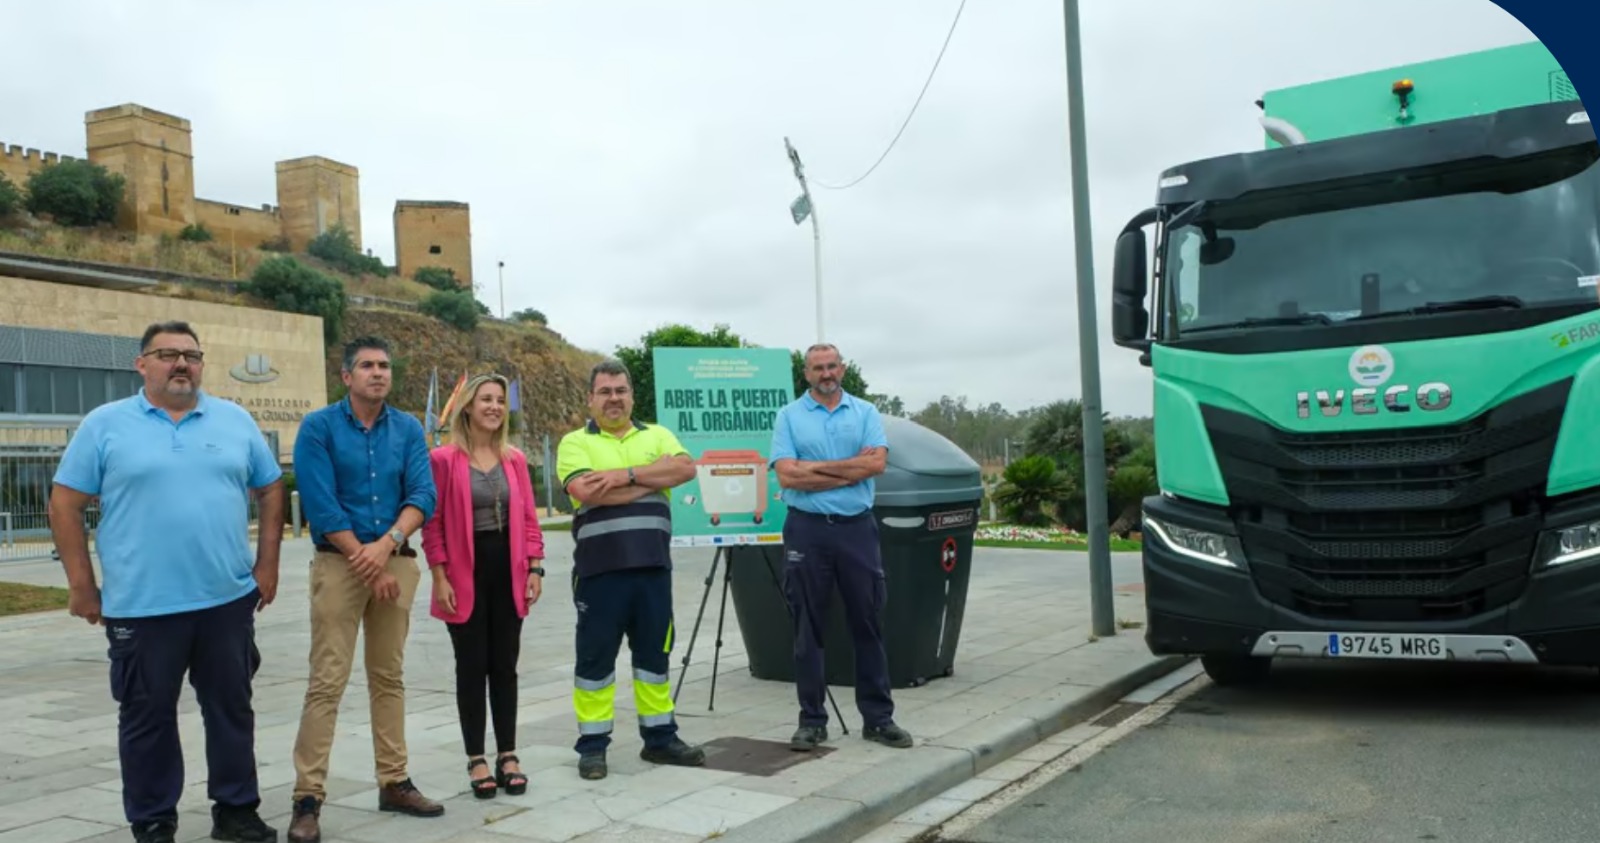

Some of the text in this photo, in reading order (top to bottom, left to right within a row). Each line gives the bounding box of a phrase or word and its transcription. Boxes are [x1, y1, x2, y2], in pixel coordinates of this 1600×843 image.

[249, 398, 312, 408] AUDITORIO
[664, 388, 788, 409] ABRE LA PUERTA
[1296, 382, 1452, 419] IVECO
[679, 411, 698, 432] AL
[1341, 636, 1441, 656] 9745 MRG
